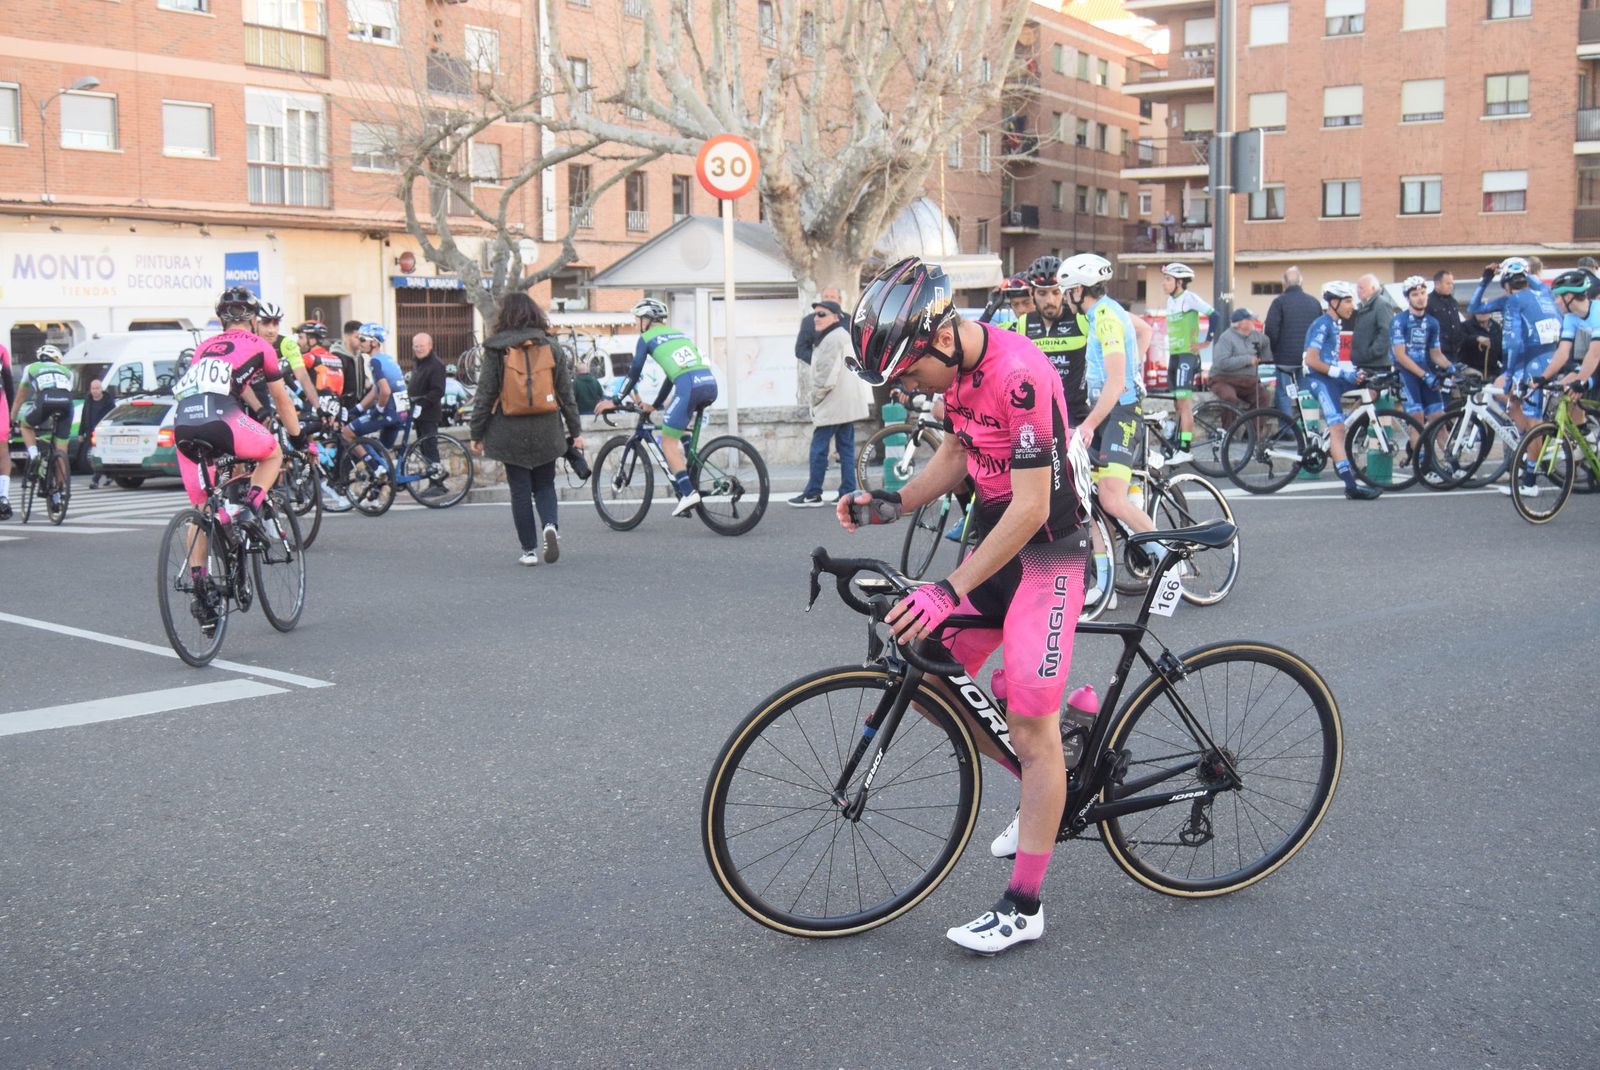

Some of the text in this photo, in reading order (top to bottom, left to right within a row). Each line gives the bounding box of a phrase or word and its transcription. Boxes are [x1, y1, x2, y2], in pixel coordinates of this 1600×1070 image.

[711, 156, 746, 177] 30
[12, 246, 115, 280] MONTÓ
[135, 255, 203, 269] PINTURA Y
[62, 286, 118, 297] TIENDAS
[128, 272, 212, 288] DECORACIÓN
[674, 349, 692, 363] 34
[200, 359, 231, 385] 163
[946, 403, 1001, 430] AGLIA
[861, 443, 875, 461] LEVEL
[1158, 581, 1180, 610] 166
[1037, 575, 1069, 677] MAGLIA
[948, 675, 1018, 756] JOR
[865, 747, 883, 788] JORBI
[1169, 790, 1208, 801] JORBI
